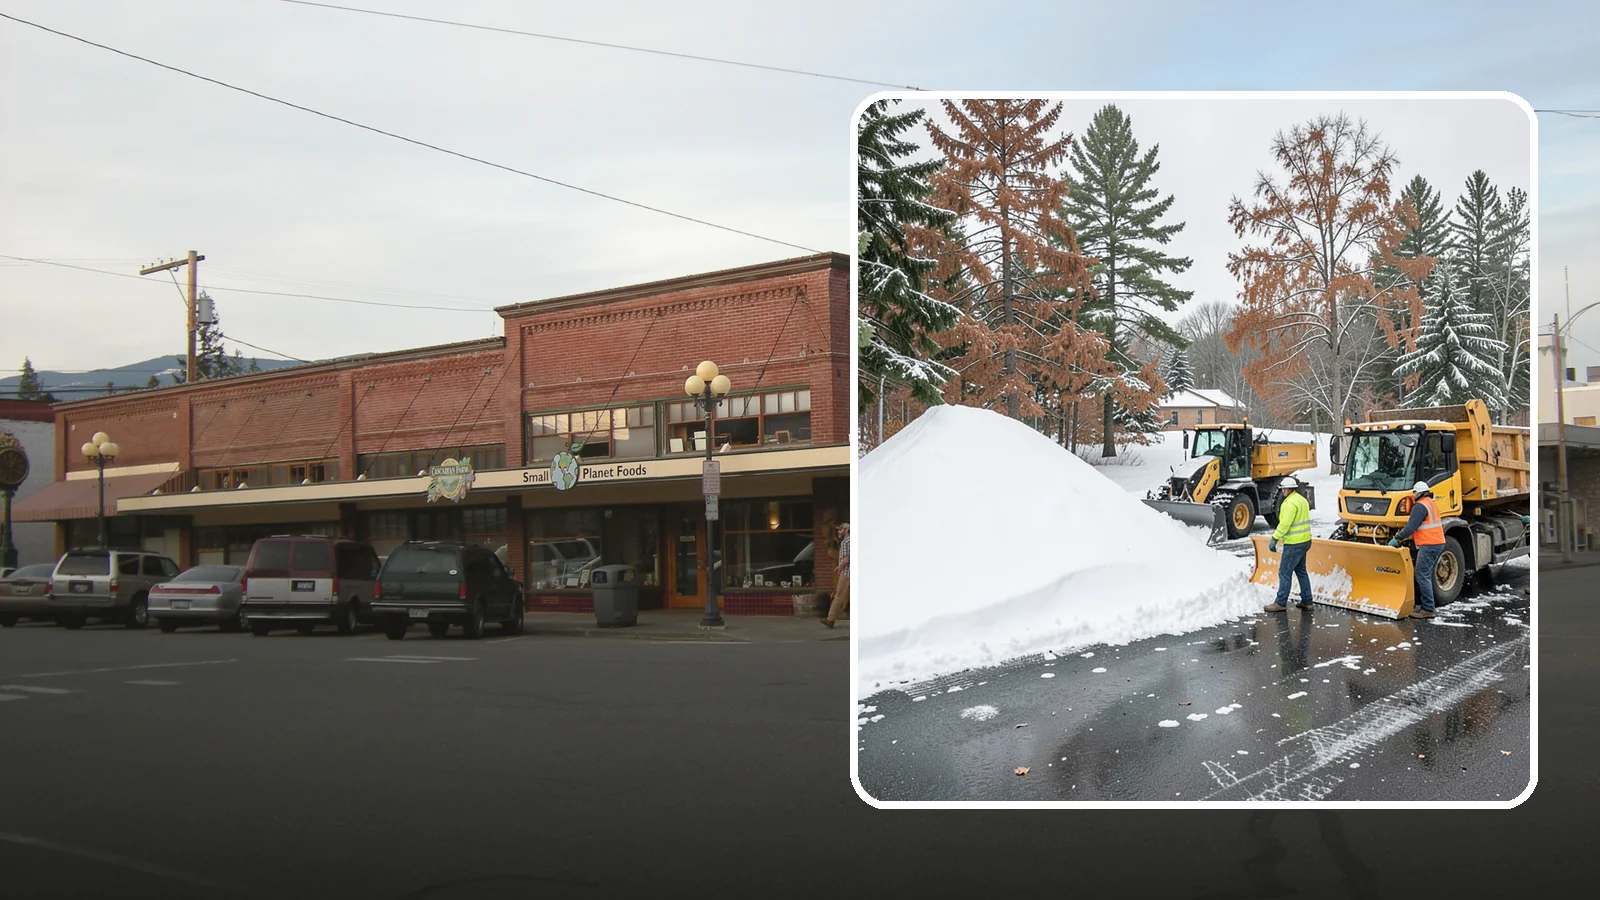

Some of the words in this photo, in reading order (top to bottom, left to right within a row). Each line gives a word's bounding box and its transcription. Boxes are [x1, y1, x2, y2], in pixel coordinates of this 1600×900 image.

[523, 471, 549, 483] Small
[582, 467, 614, 479] Planet
[616, 464, 647, 477] Foods
